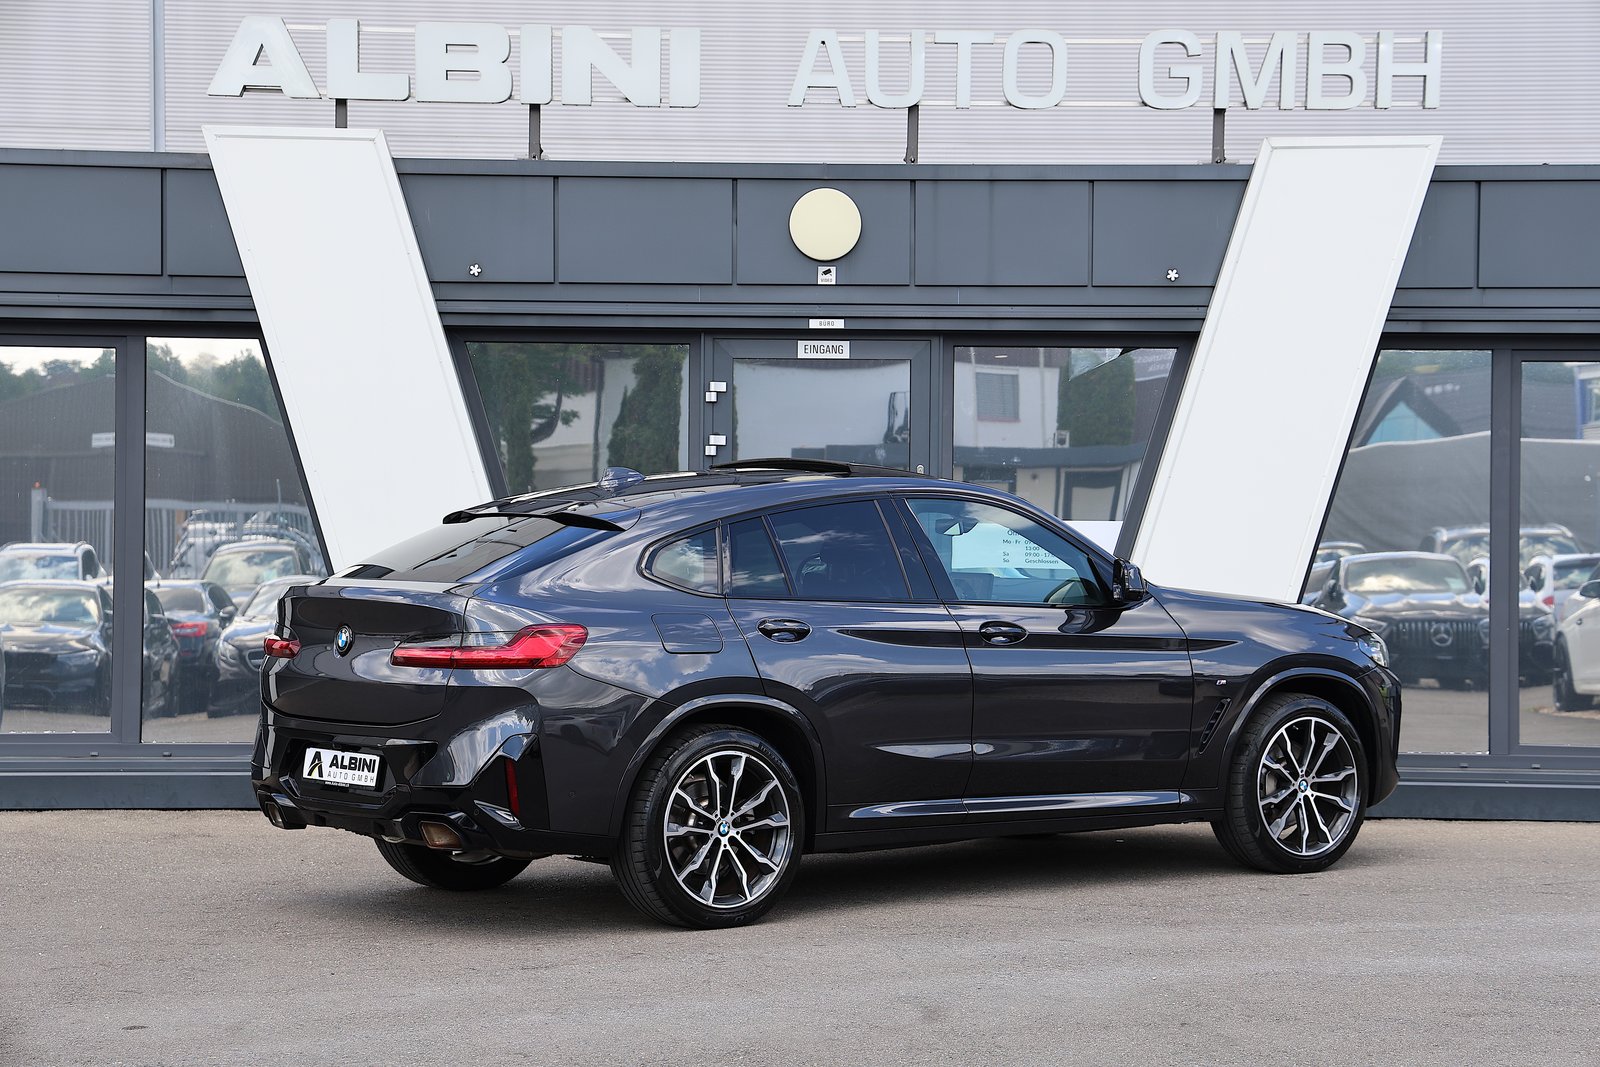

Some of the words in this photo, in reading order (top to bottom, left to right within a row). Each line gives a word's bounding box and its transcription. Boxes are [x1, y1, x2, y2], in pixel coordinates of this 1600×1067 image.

[207, 16, 701, 108] ALBINI
[787, 29, 1068, 109] AUTO
[1137, 29, 1443, 110] GMBH
[804, 344, 844, 355] EINGANG
[329, 754, 376, 773] ALBINI
[327, 771, 349, 780] AUTO
[352, 774, 374, 783] GMBH
